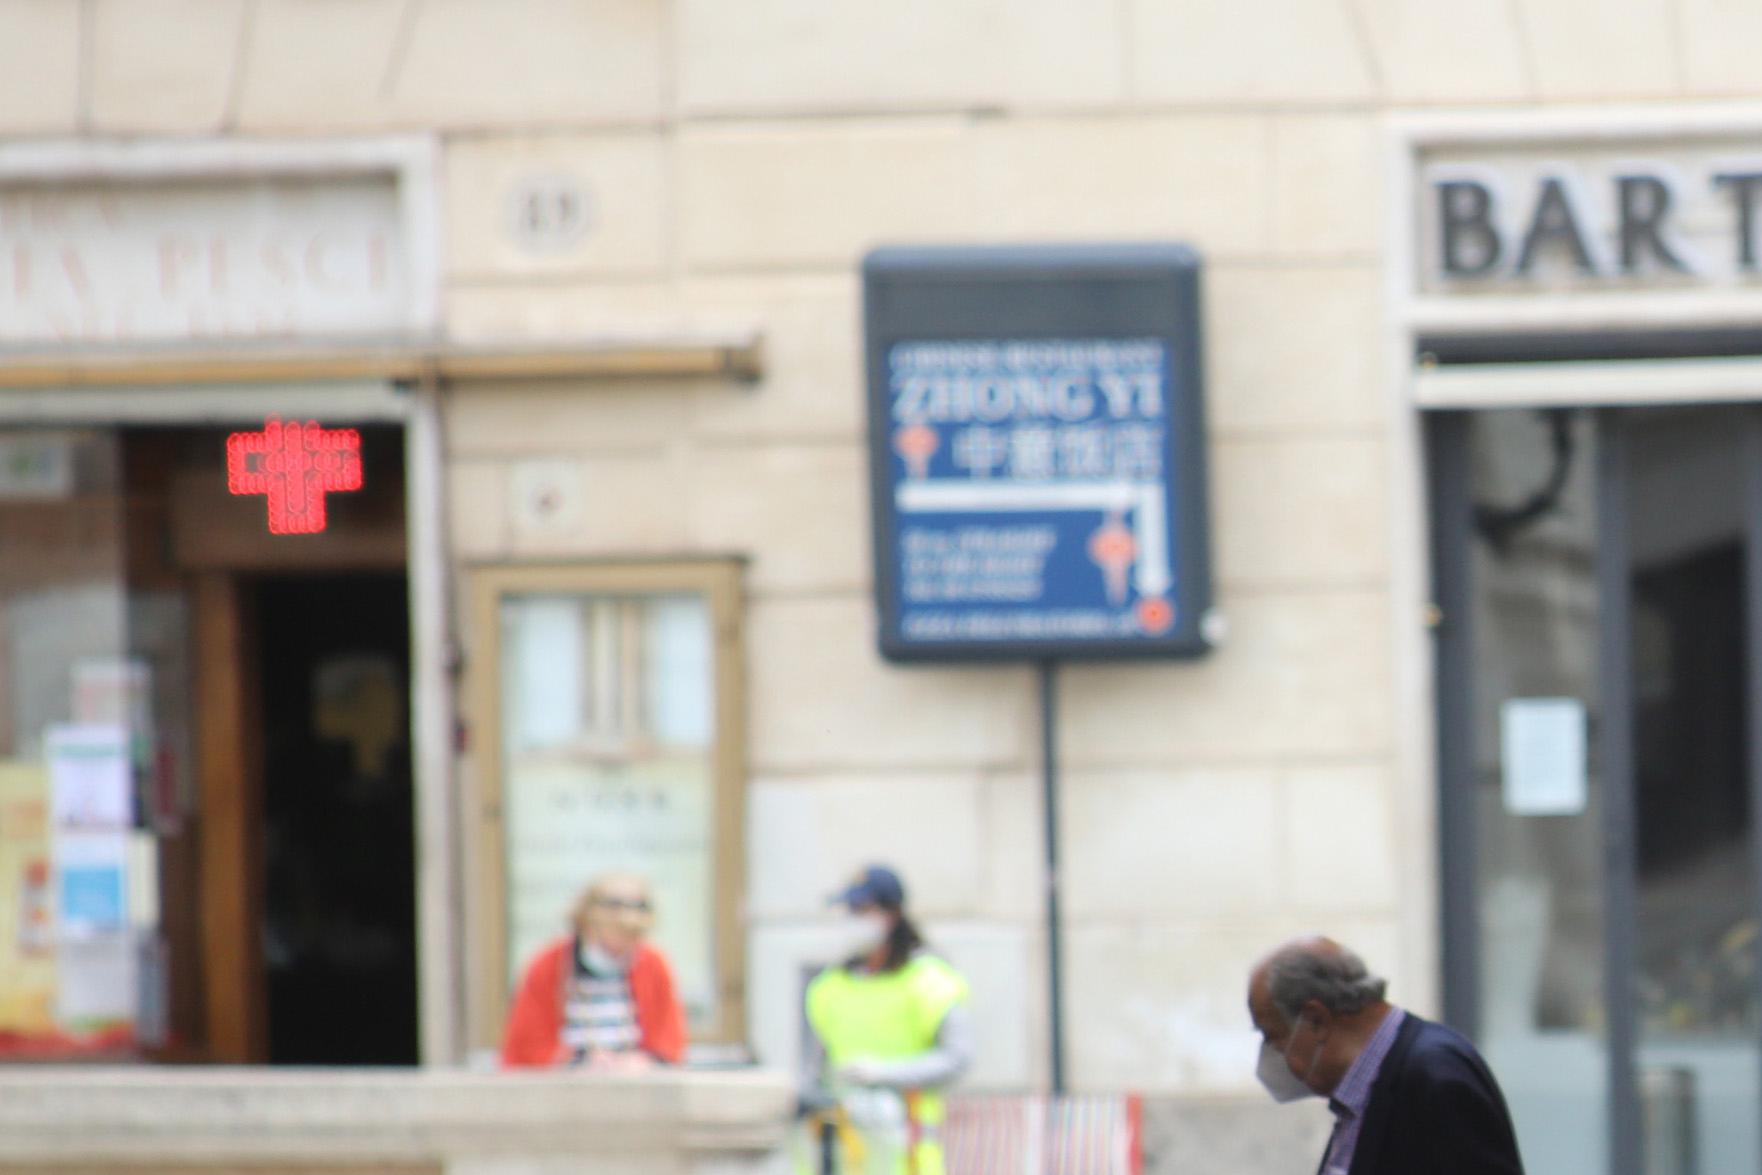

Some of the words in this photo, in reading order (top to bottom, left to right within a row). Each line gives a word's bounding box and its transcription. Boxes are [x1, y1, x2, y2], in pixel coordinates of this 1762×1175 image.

[1434, 174, 1697, 278] BAR
[891, 369, 1094, 423] ZHONG
[1098, 367, 1162, 418] YI
